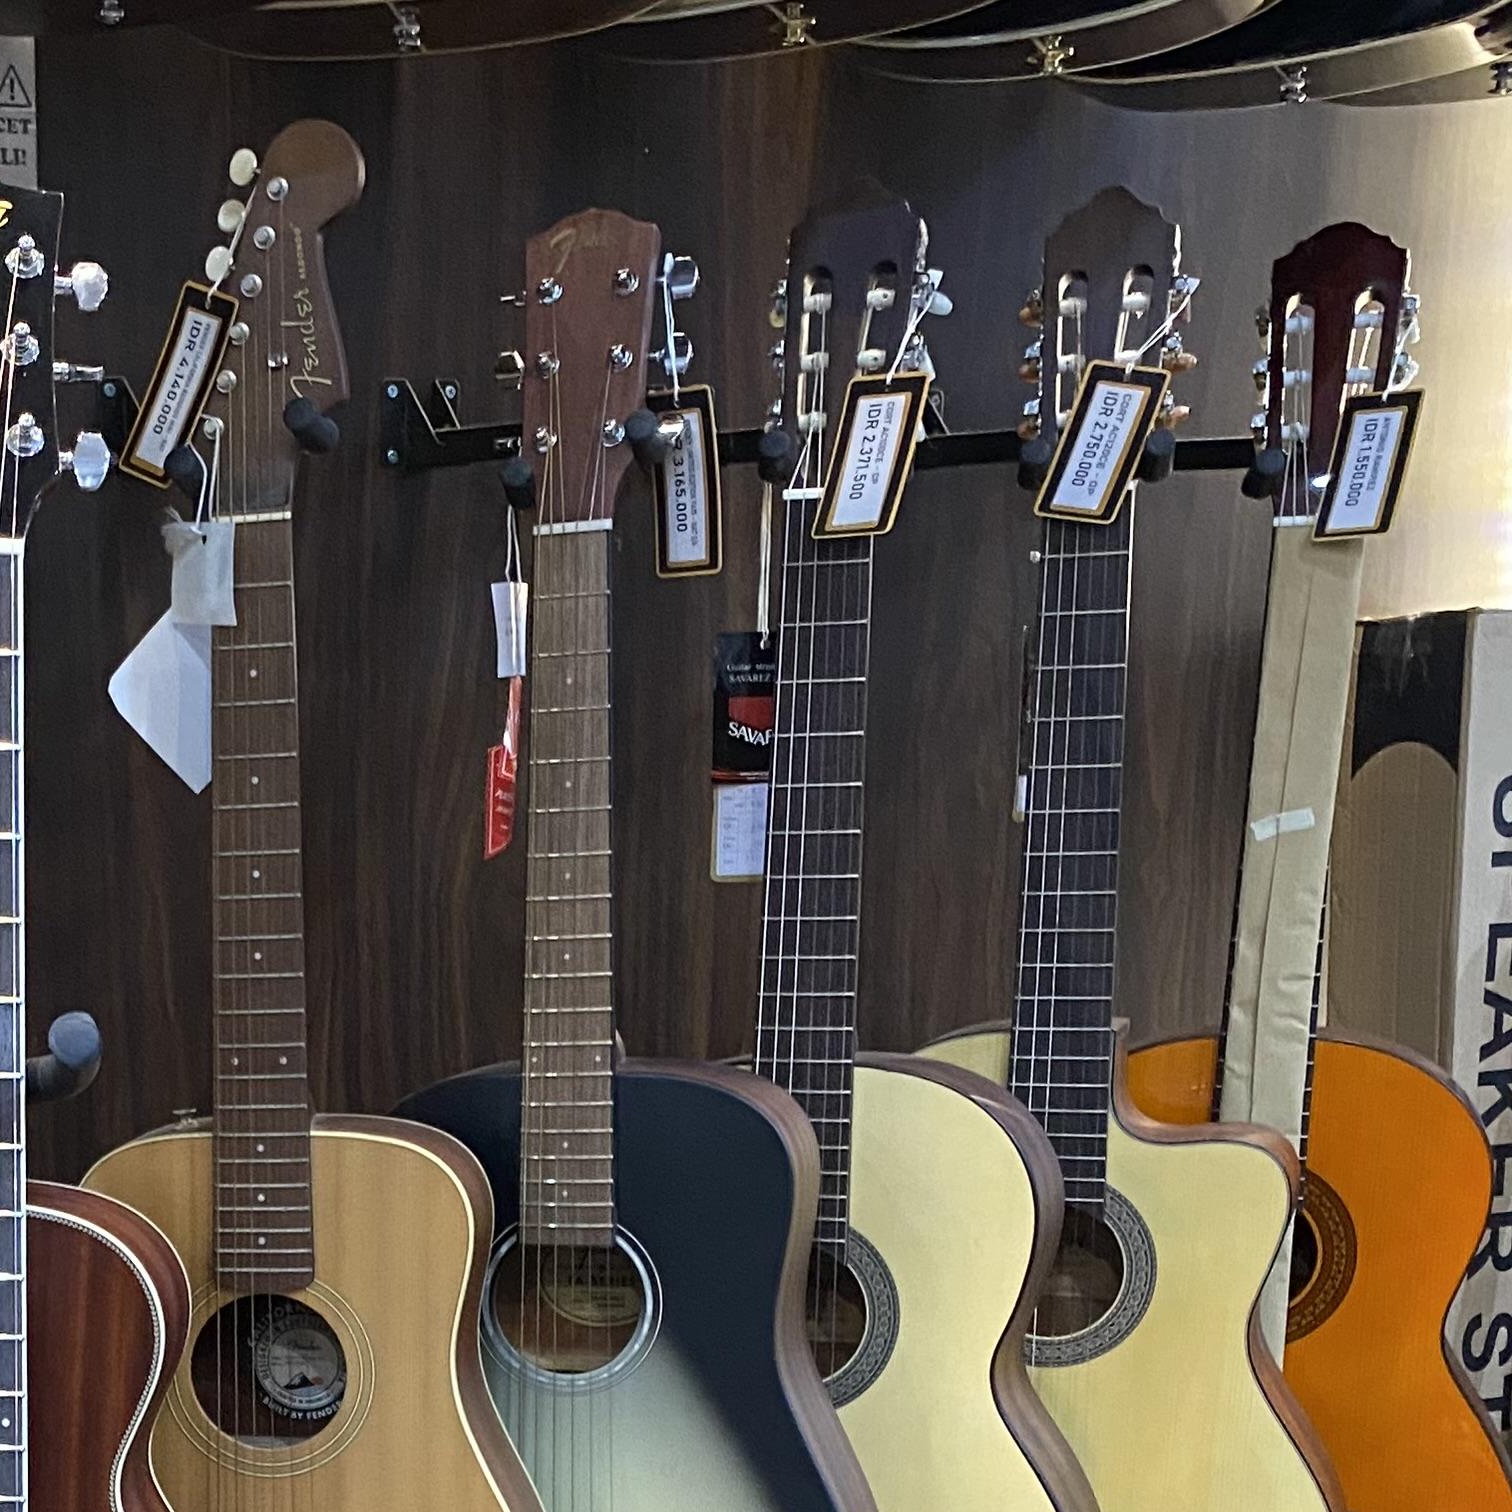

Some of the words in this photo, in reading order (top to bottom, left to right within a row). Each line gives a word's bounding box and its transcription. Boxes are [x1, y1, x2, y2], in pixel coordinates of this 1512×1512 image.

[185, 319, 202, 351] IDR
[280, 287, 332, 398] Fender
[153, 357, 189, 435] 4.140.000
[865, 403, 882, 430] IDR
[1099, 391, 1119, 417] IDR
[1116, 393, 1132, 424] CORT
[1072, 421, 1108, 487] 2.750.000
[1362, 418, 1379, 443] IDR
[673, 456, 688, 532] 3.165.000
[849, 435, 875, 500] 2.371.500
[1345, 446, 1372, 507] 1.550.000
